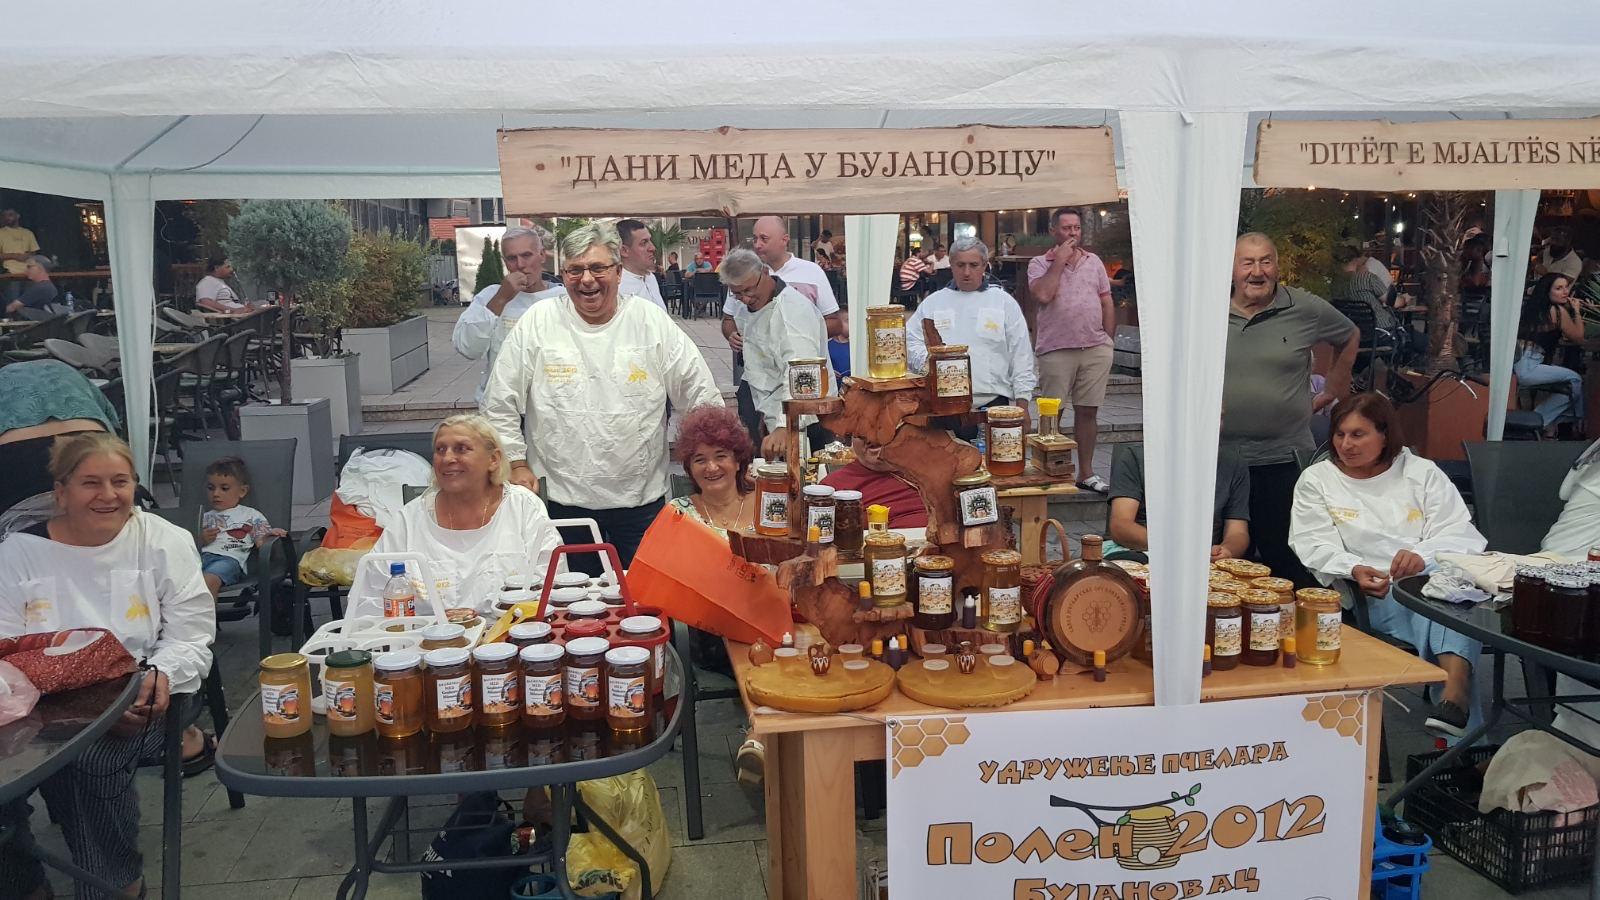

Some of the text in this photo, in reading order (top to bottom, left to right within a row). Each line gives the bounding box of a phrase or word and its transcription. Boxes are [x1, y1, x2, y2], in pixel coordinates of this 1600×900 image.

[560, 148, 1056, 189] "ДАНИ МЕДА У БУЈАНОВЦУ"
[1300, 136, 1398, 165] "DITËT
[1406, 141, 1425, 164] E
[1433, 136, 1560, 164] MJALTËS
[979, 741, 1288, 785] УДРУЖЕЊЕ ПЧЕЛАРА
[926, 794, 1327, 866] Полен 2012
